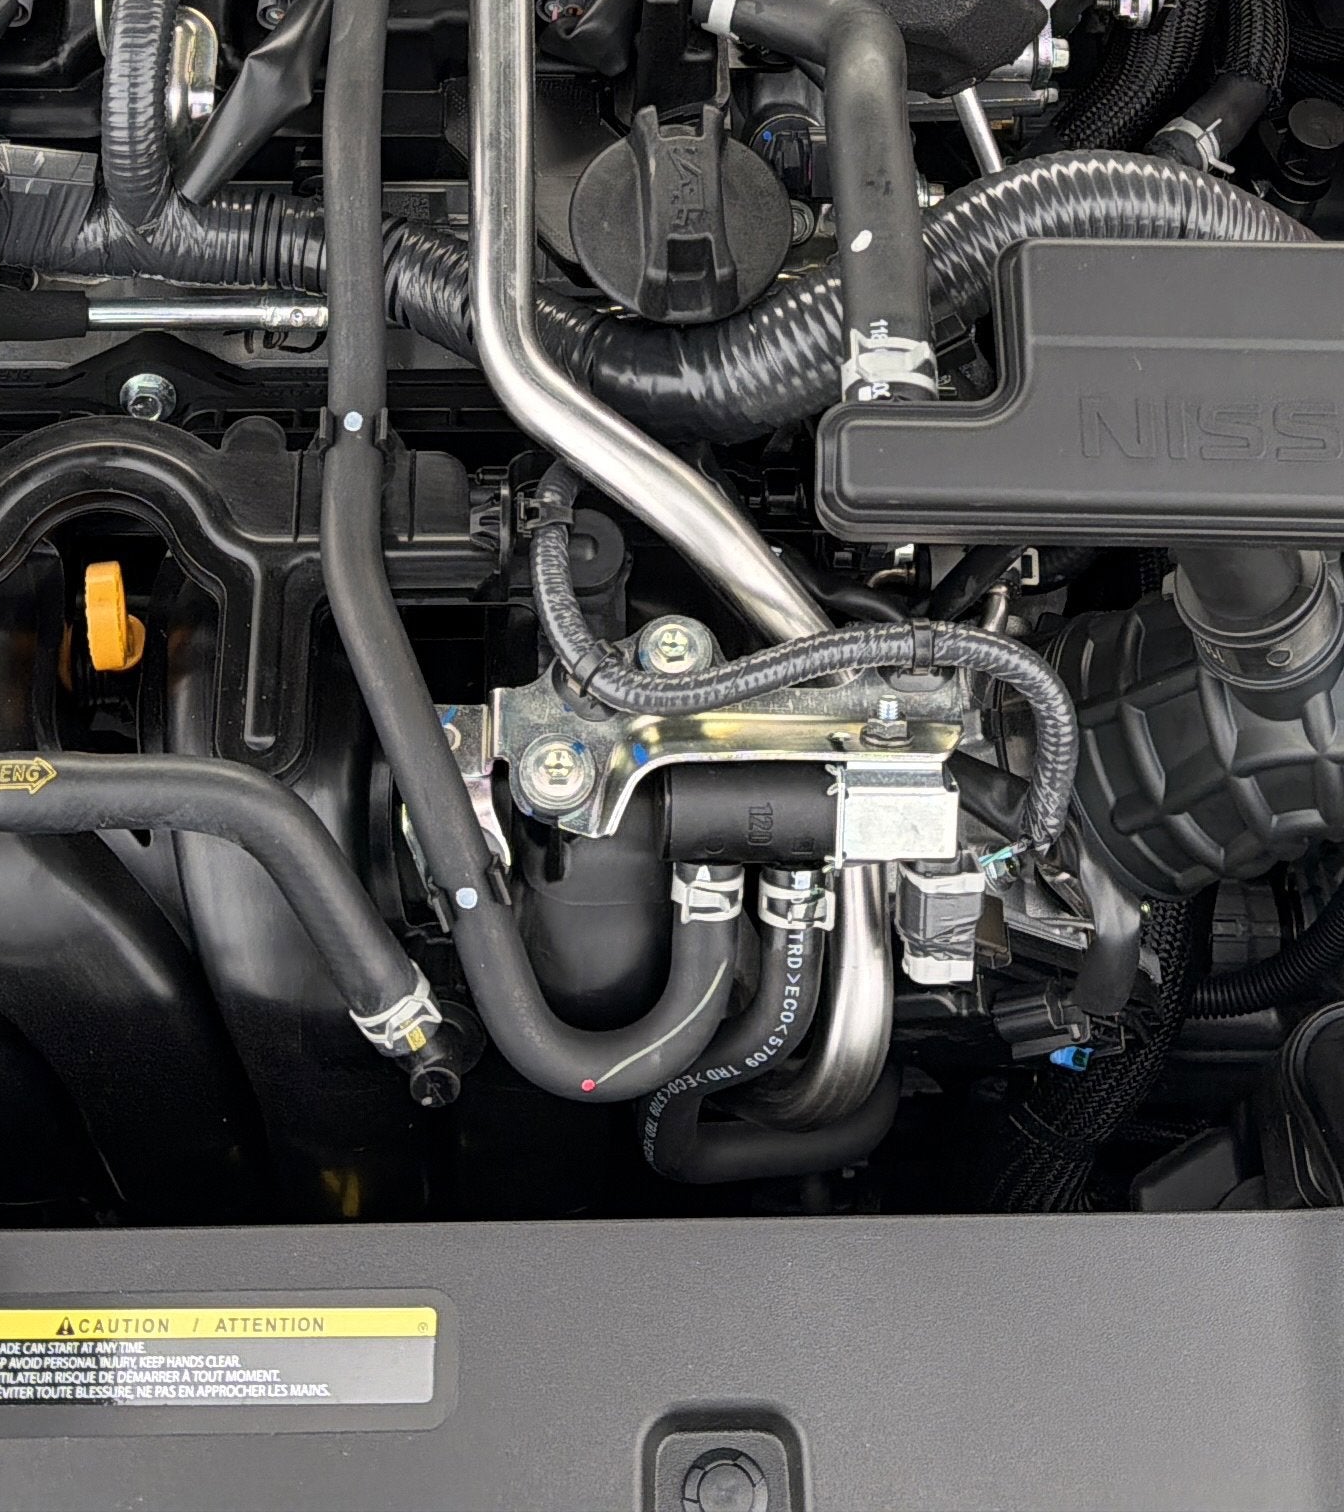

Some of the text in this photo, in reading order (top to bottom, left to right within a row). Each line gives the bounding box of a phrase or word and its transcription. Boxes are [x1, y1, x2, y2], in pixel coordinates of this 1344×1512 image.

[78, 1317, 170, 1334] CAUTION
[214, 1317, 325, 1333] ATTENTION
[22, 1341, 44, 1354] CAN
[44, 1341, 78, 1354] START
[80, 1341, 94, 1353] AT
[95, 1341, 118, 1353] ANY
[118, 1341, 146, 1354] TIME.
[8, 1356, 42, 1369] AVOID
[43, 1356, 97, 1369] PERSONAL
[139, 1355, 165, 1368] KEEP
[166, 1354, 204, 1368] HANDS
[205, 1354, 241, 1368] CLEAR.
[54, 1370, 97, 1385] RISQUE
[98, 1370, 115, 1383] DE
[191, 1369, 224, 1382] TOUT
[225, 1369, 280, 1382] MOMENT.
[36, 1385, 73, 1399] TOUTE
[136, 1385, 153, 1398] NE
[154, 1385, 176, 1398] PAS
[178, 1385, 195, 1398] EN
[194, 1384, 268, 1398] APPROCHER
[268, 1384, 288, 1397] LES
[289, 1383, 330, 1397] MAINS.
